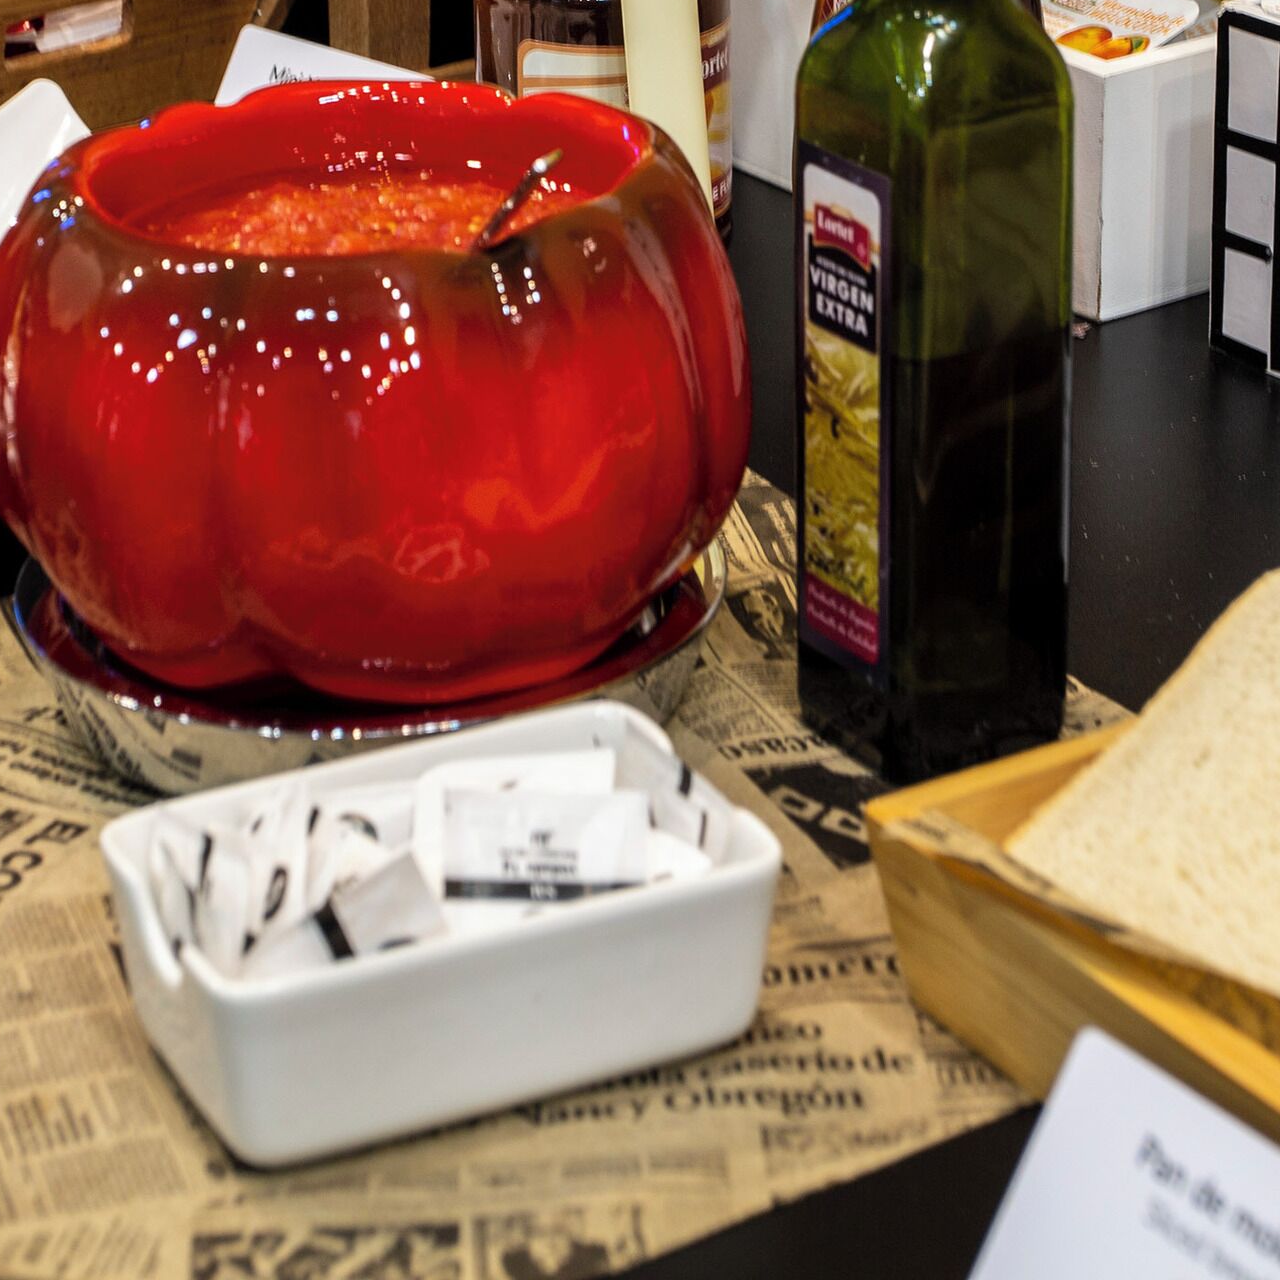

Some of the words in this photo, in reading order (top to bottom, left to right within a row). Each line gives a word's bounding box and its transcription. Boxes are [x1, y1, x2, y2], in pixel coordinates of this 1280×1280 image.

[810, 265, 873, 314] VIRGEN
[816, 290, 869, 338] EXTRA
[23, 819, 90, 845] EL
